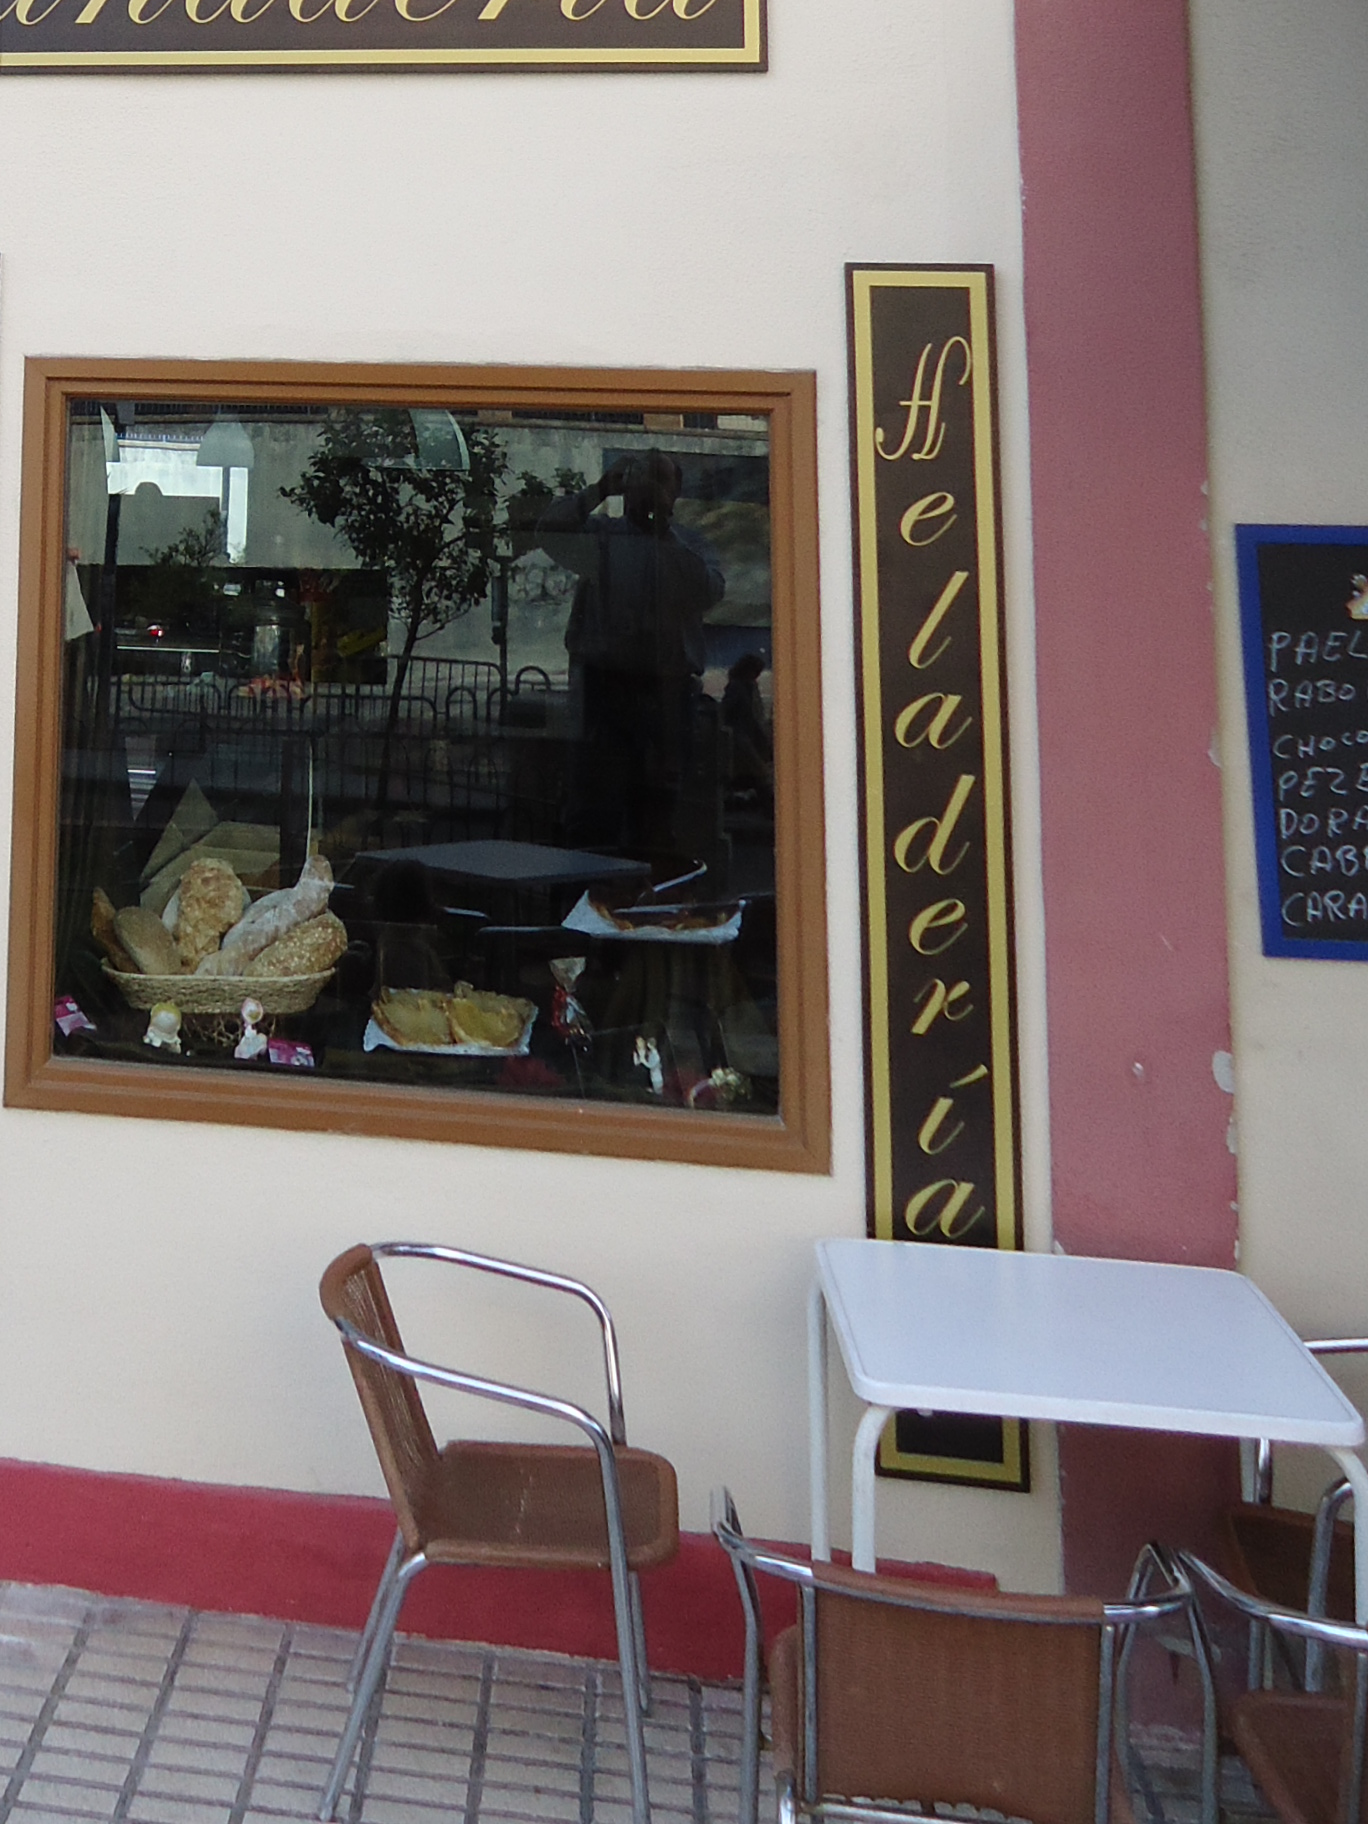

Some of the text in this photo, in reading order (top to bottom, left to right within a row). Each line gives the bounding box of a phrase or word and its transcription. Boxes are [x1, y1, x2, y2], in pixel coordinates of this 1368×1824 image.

[1268, 678, 1357, 718] RABO
[875, 335, 986, 1241] Heladería
[1280, 844, 1368, 878] CAB
